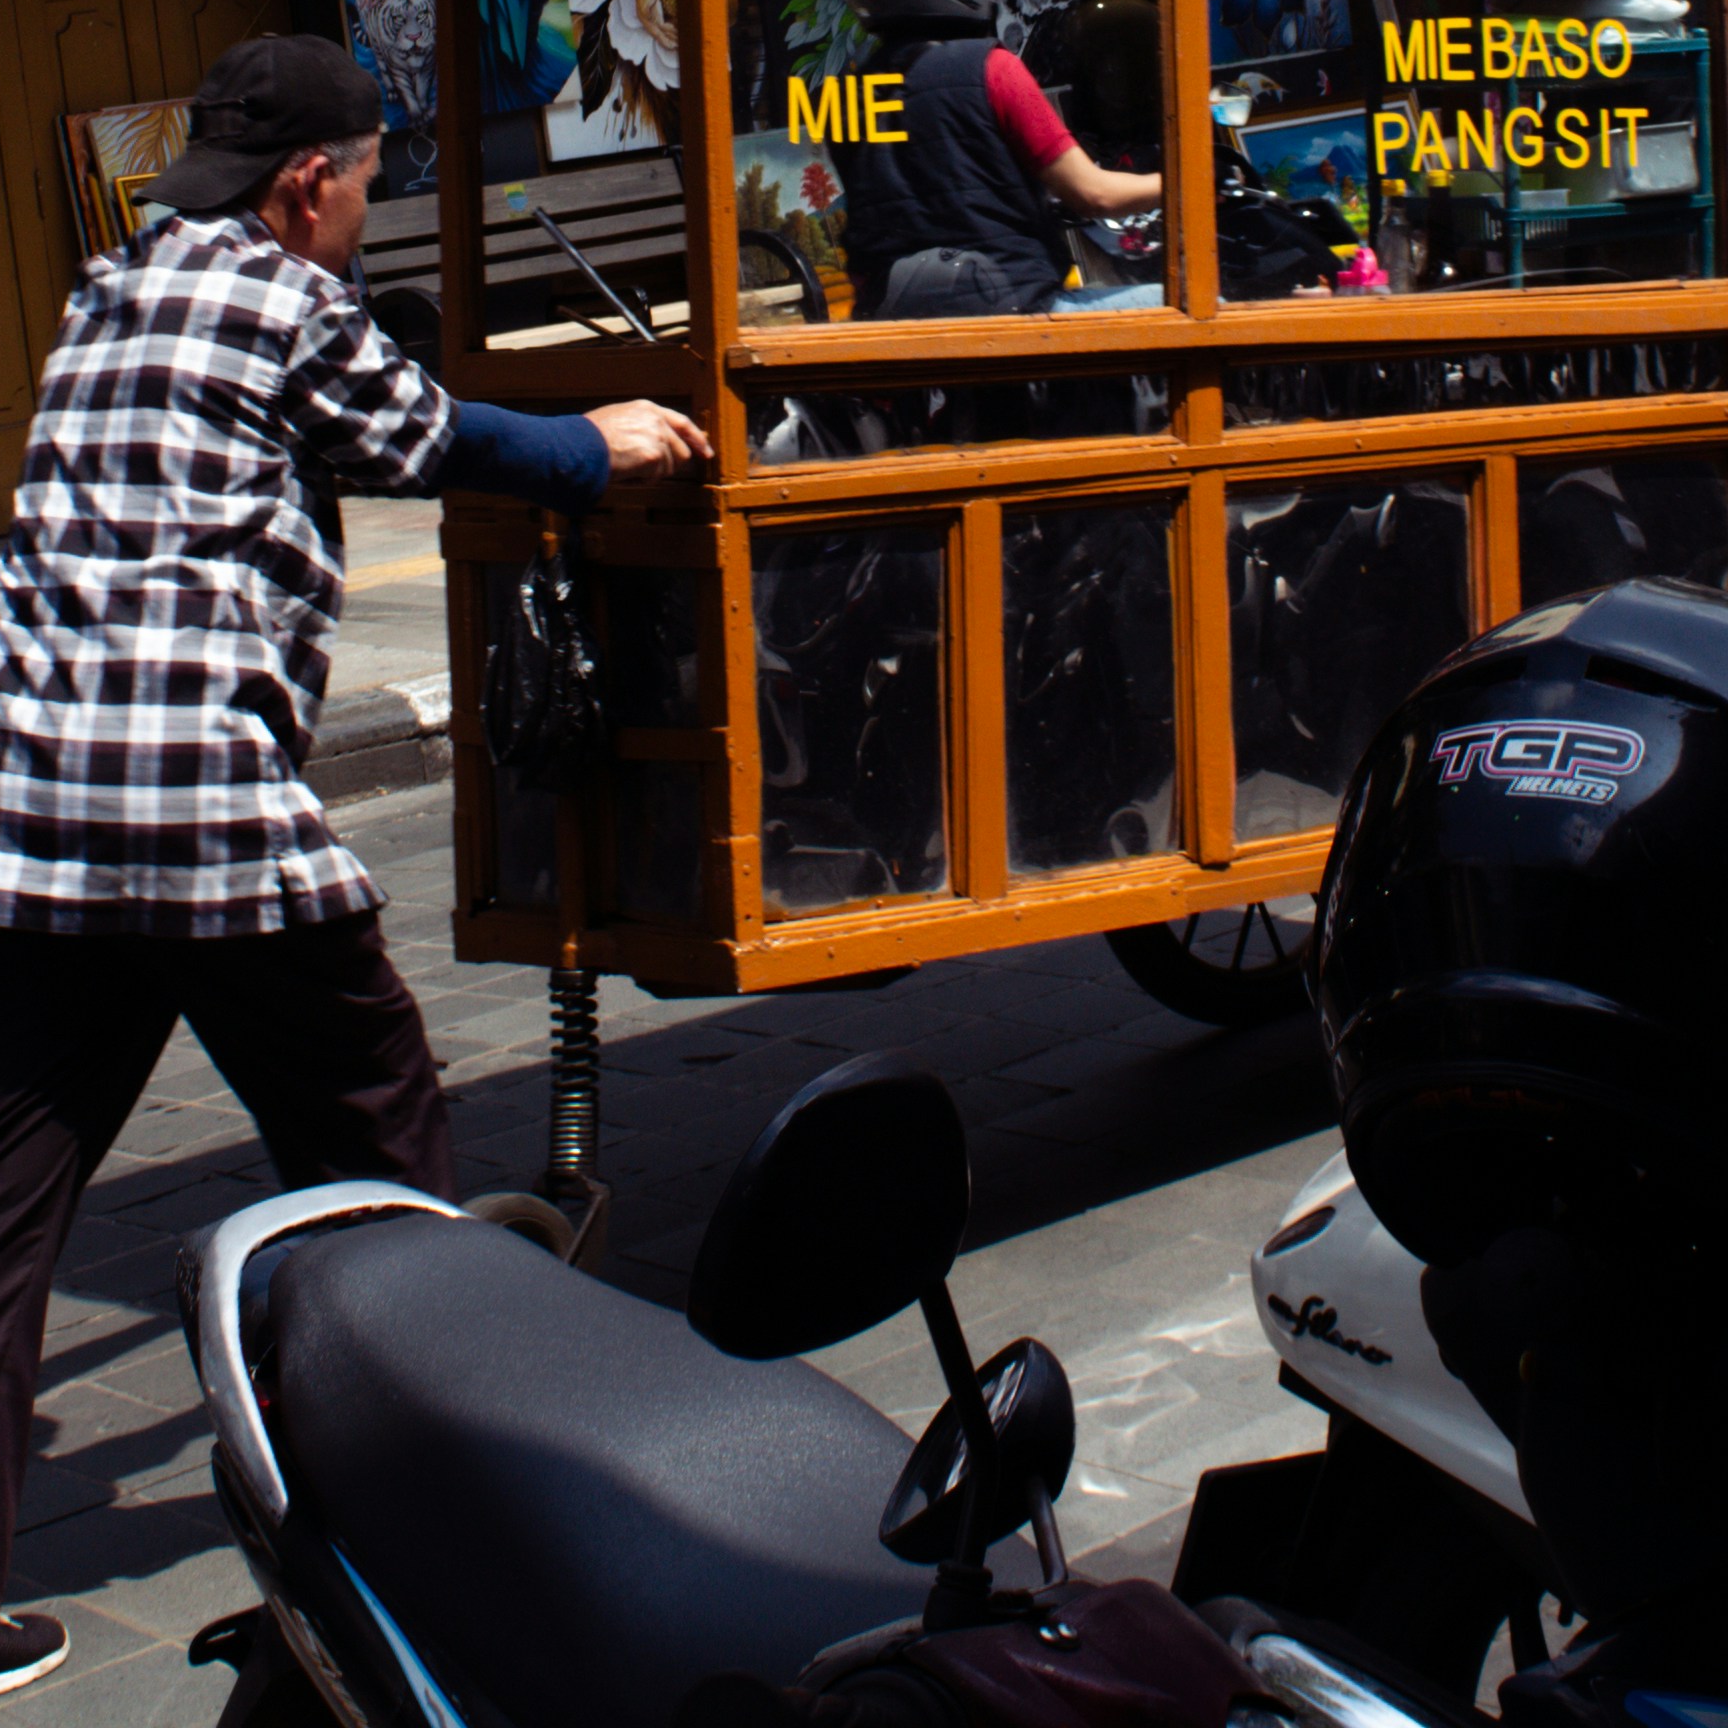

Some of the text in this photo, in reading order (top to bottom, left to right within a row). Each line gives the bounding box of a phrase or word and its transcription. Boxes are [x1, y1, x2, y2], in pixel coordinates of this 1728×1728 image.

[1382, 17, 1633, 84] MIE BASO
[787, 73, 910, 146] MIE
[1373, 106, 1650, 176] PANGSIT
[1430, 719, 1645, 785] TGP
[1515, 775, 1613, 801] HELMETS
